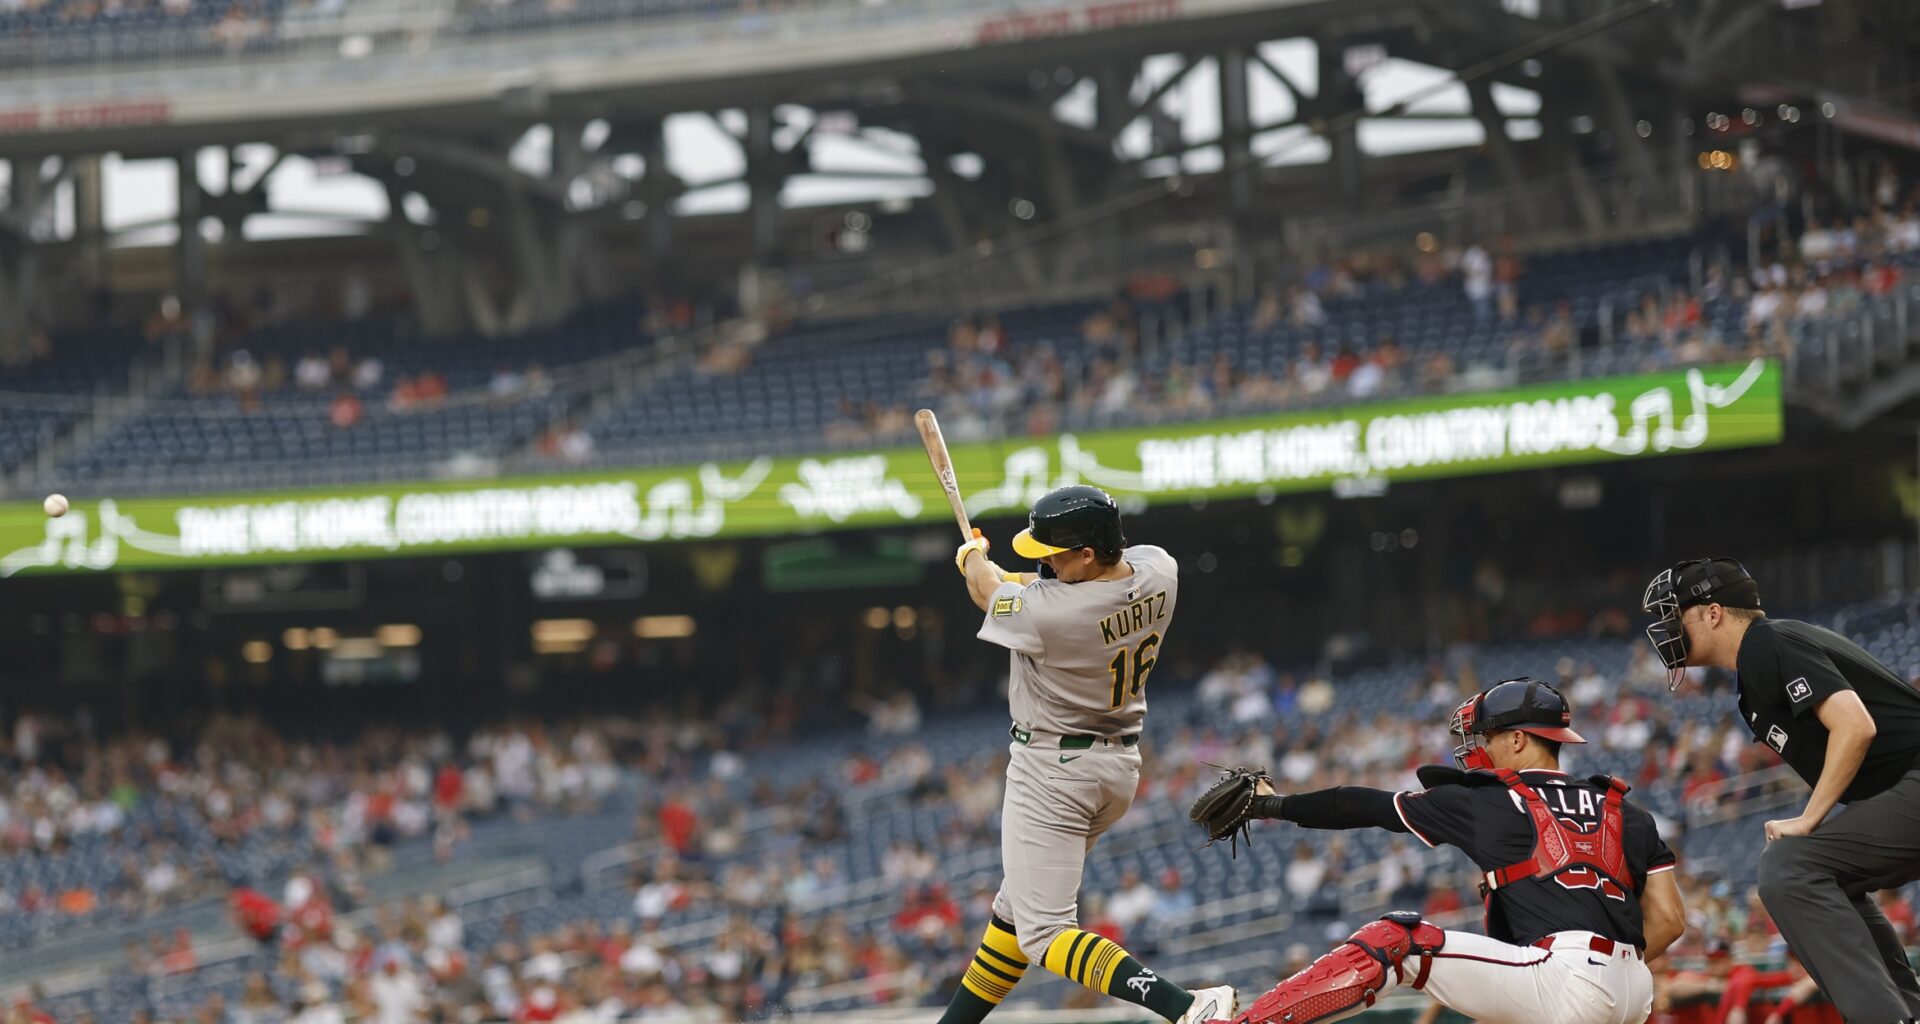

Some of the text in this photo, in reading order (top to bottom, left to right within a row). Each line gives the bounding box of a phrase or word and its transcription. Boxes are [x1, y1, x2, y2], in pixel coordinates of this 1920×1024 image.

[1137, 434, 1215, 491] TAKE
[1217, 429, 1265, 485] ME
[1366, 407, 1507, 471] COUNTRY
[1508, 392, 1619, 455] ROADS
[251, 502, 298, 552] ME
[397, 490, 529, 544] COUNTRY
[1098, 590, 1166, 648] KURTZ
[1107, 631, 1159, 710] 16
[1793, 683, 1807, 697] JS
